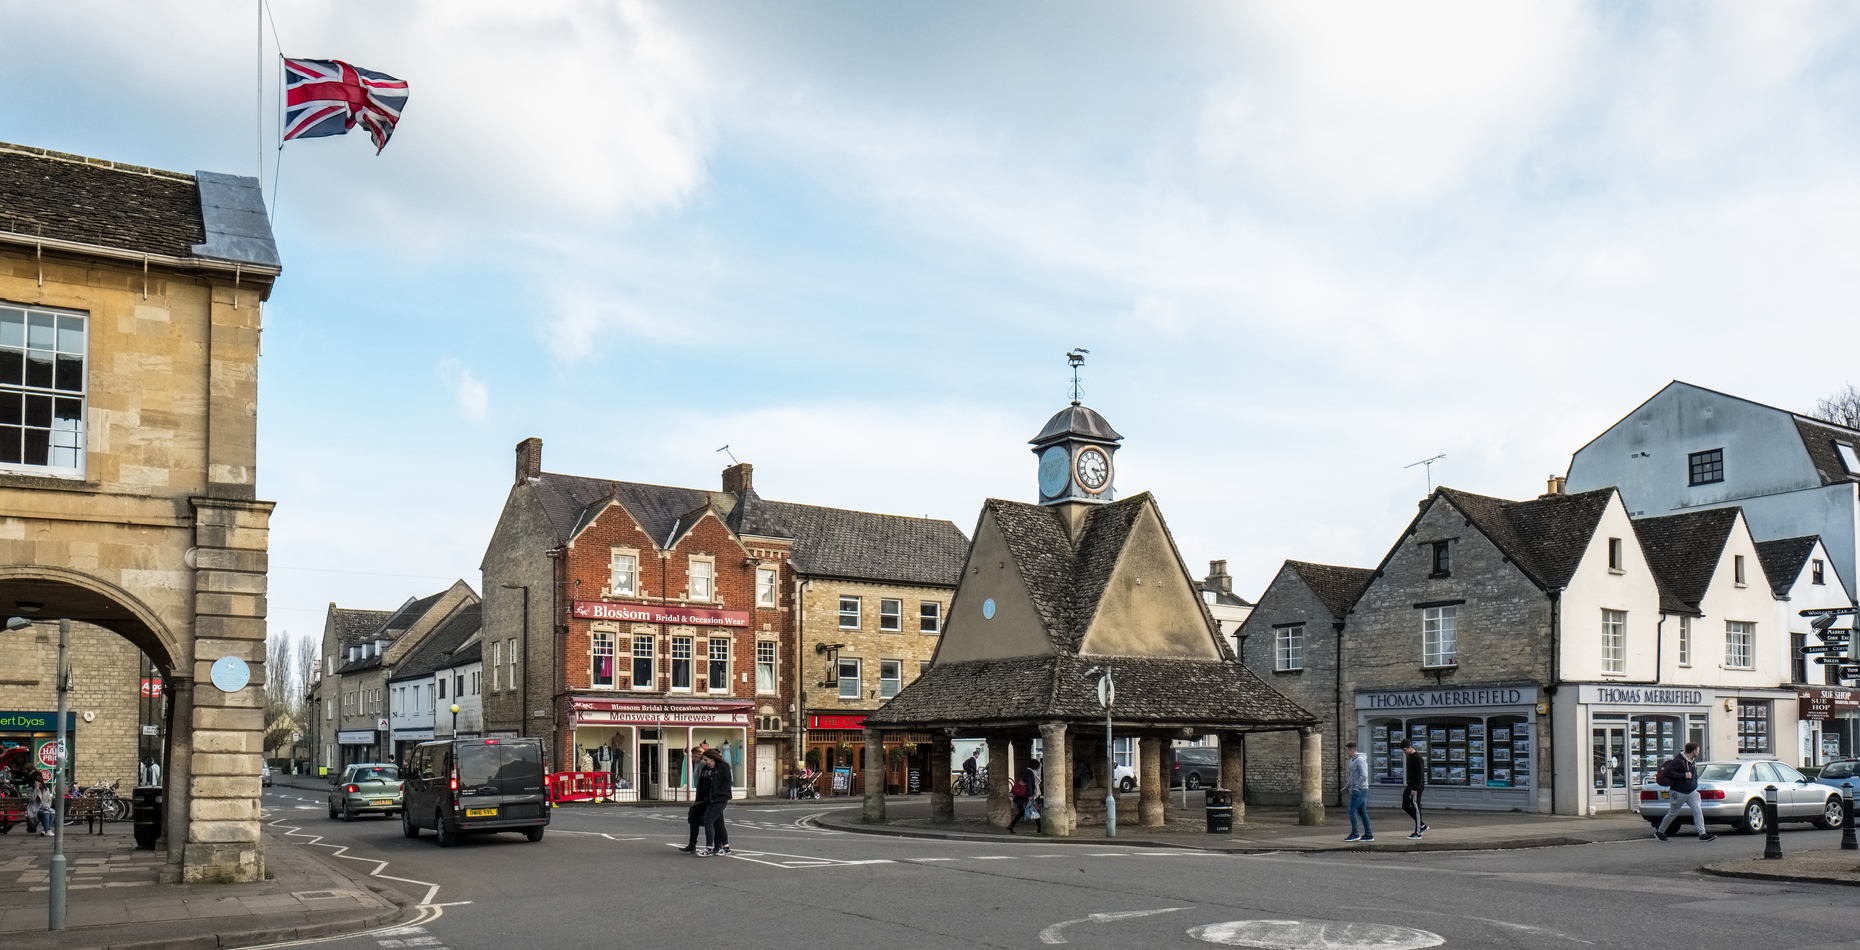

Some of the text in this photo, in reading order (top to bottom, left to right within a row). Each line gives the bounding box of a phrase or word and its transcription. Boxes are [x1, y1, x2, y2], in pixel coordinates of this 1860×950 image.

[593, 605, 650, 620] Blossom
[655, 614, 680, 622] Bridal
[689, 616, 723, 624] Occasion
[724, 617, 745, 625] Wear
[1367, 689, 1521, 708] THOMAS MERRIFIELD
[1597, 688, 1702, 704] THOMAS MERRIFIELD
[1834, 691, 1851, 700] SHOP
[18, 716, 45, 728] Dyas
[610, 712, 716, 722] Menswear & Hirewear
[823, 718, 838, 726] THE
